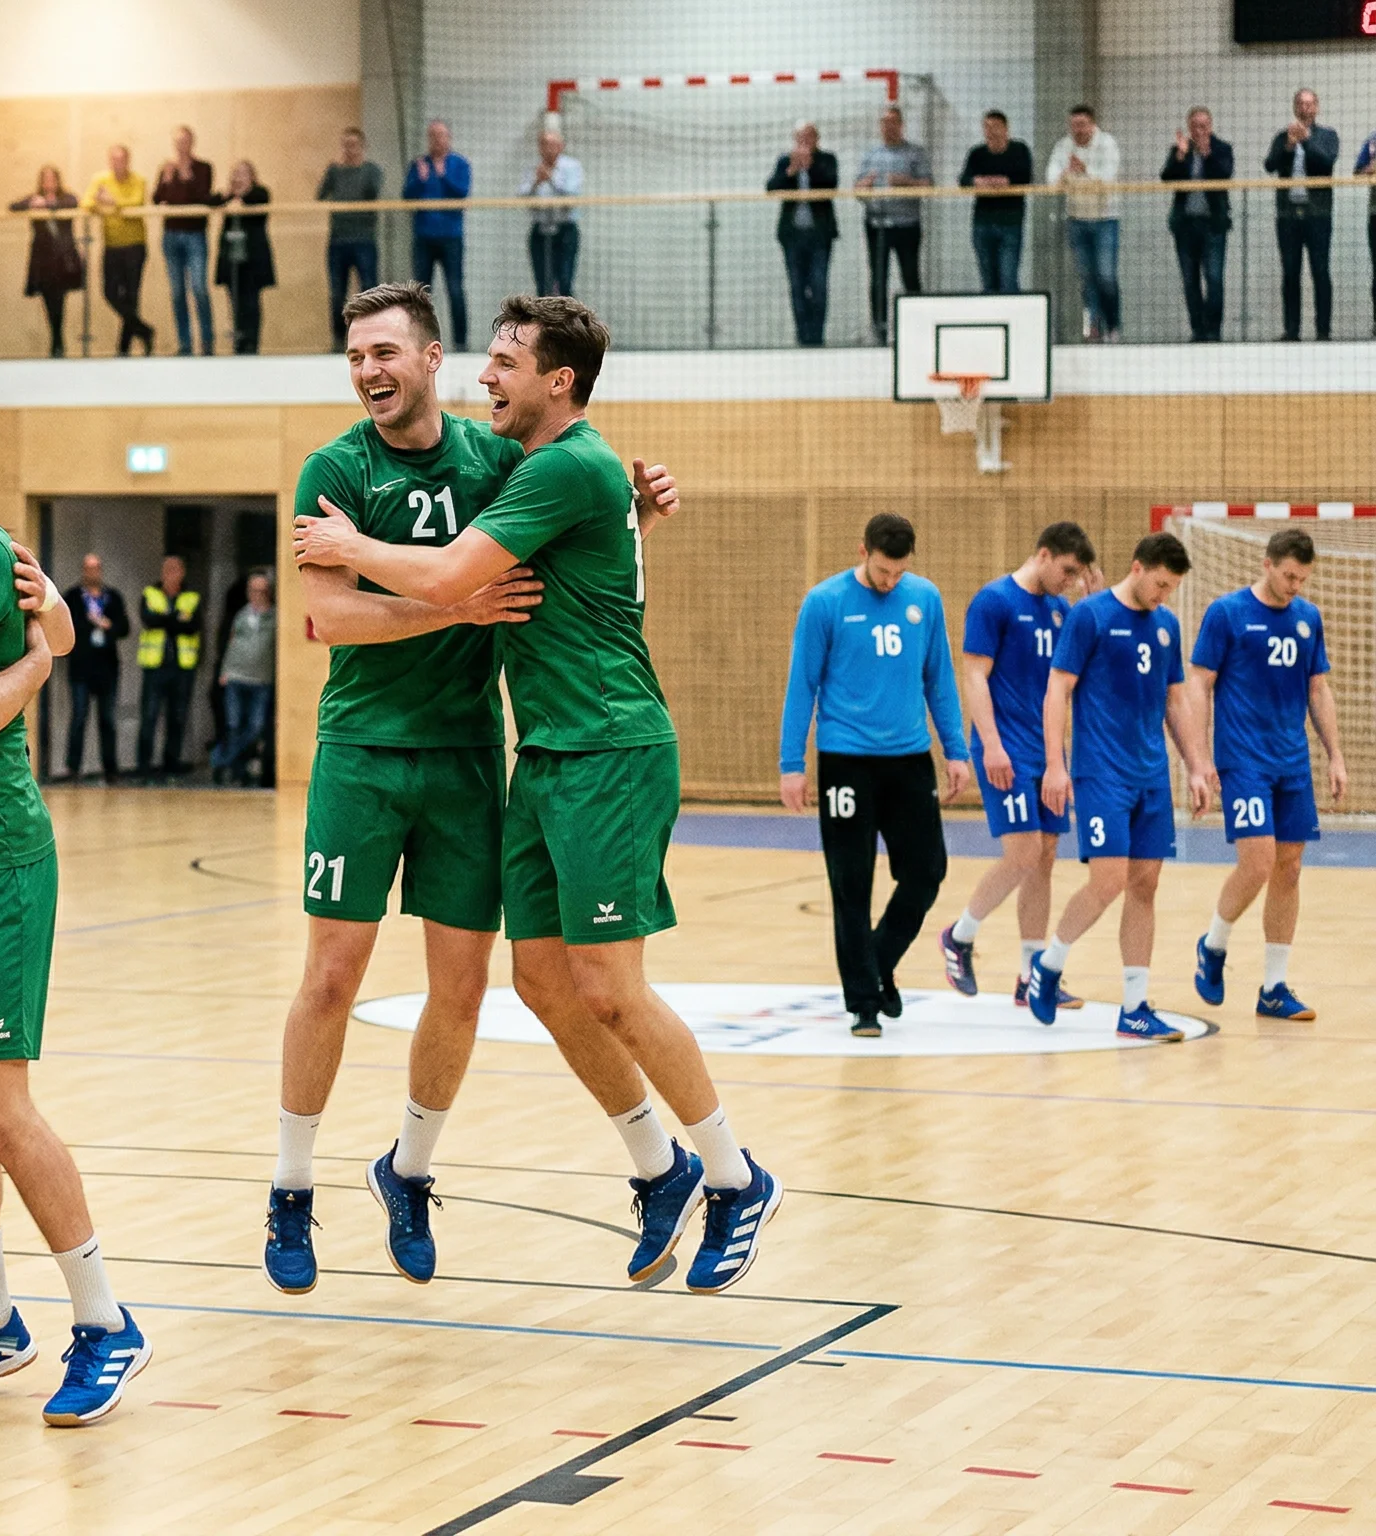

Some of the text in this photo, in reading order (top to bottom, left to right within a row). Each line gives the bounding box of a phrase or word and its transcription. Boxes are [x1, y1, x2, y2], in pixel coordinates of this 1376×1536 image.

[407, 485, 458, 539] 21
[871, 623, 903, 657] 16
[1034, 628, 1053, 658] 11
[1267, 636, 1298, 668] 20
[1137, 643, 1152, 675] 3
[826, 785, 856, 818] 16
[1003, 792, 1028, 824] 11
[1232, 796, 1266, 829] 20
[1089, 816, 1106, 848] 3
[307, 851, 345, 901] 21
